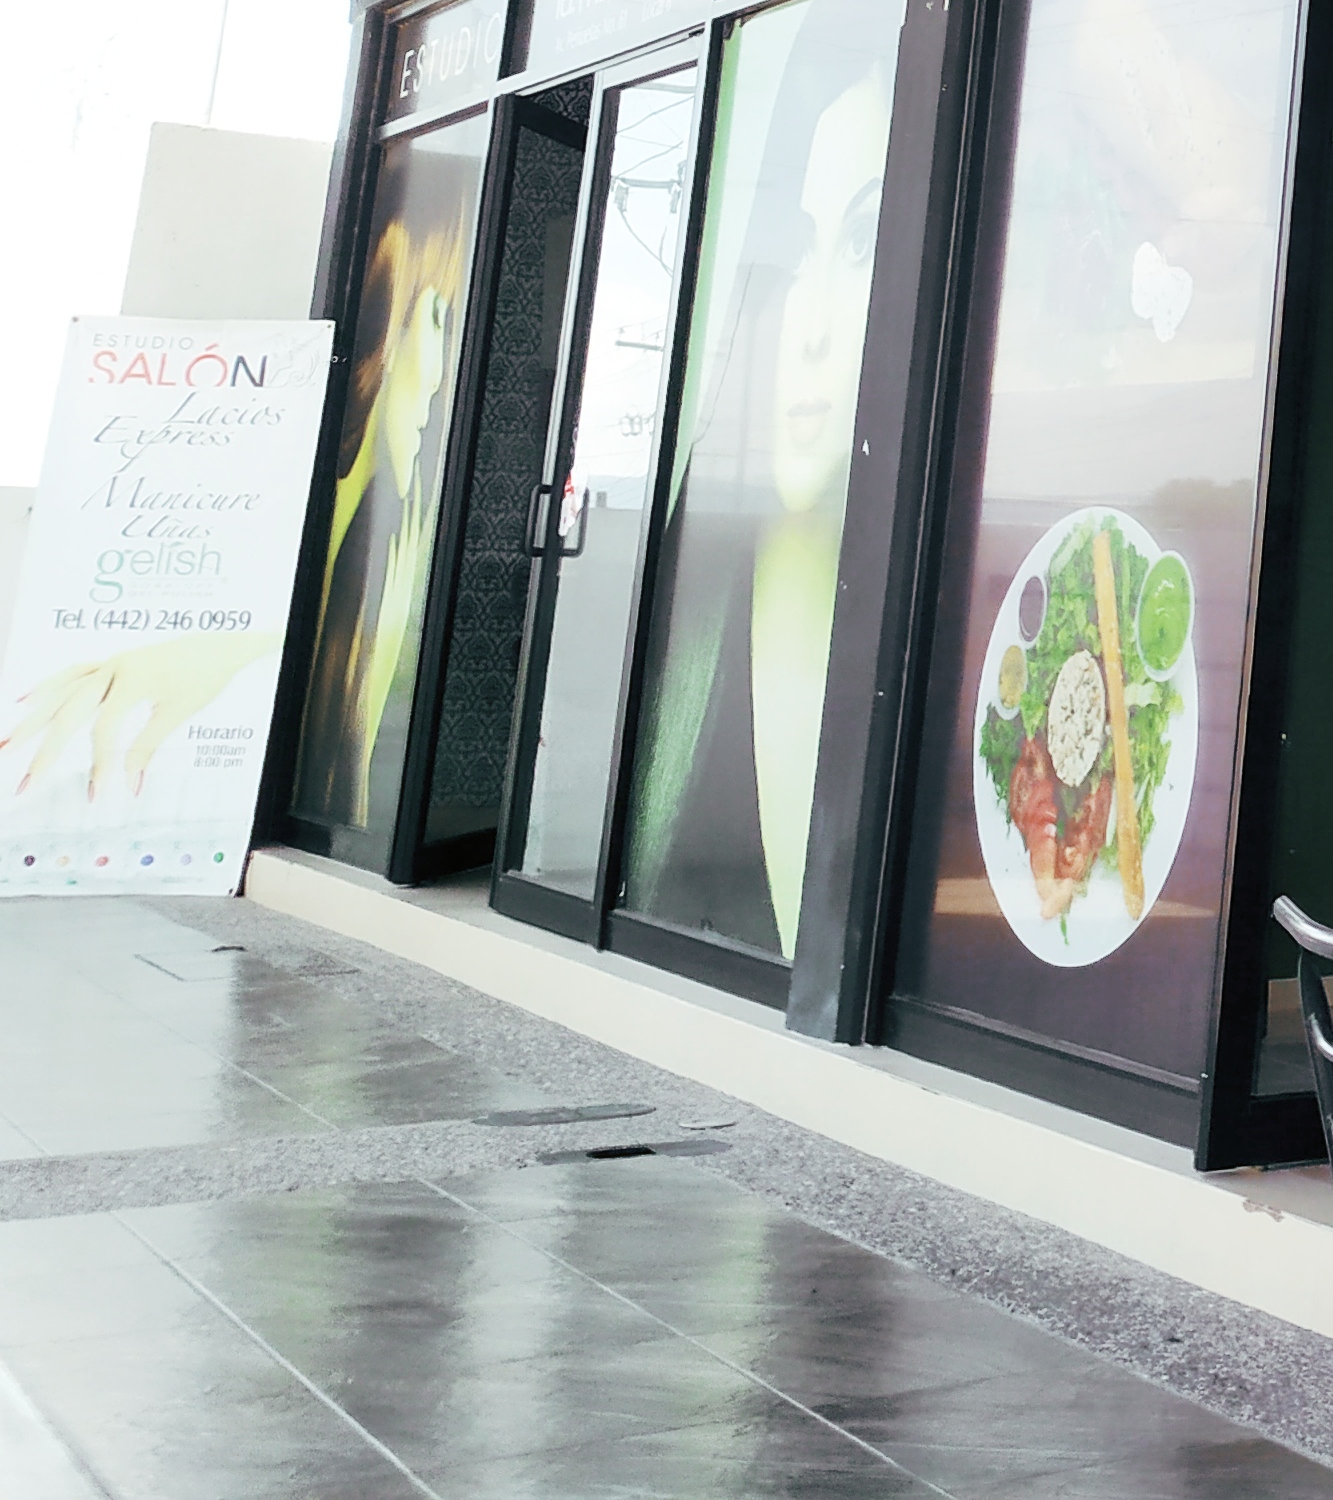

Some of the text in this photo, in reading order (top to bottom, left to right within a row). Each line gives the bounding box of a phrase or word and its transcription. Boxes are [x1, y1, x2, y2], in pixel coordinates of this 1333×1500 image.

[92, 333, 195, 350] ESTUDIO
[87, 342, 269, 388] SALÓN
[162, 390, 287, 426] Lacios
[93, 414, 235, 447] Express
[80, 474, 261, 512] Manicure
[121, 514, 212, 539] Uñas
[88, 541, 222, 604] gelish
[52, 607, 252, 633] Tel. (442) 246 0959
[187, 724, 255, 741] Horario
